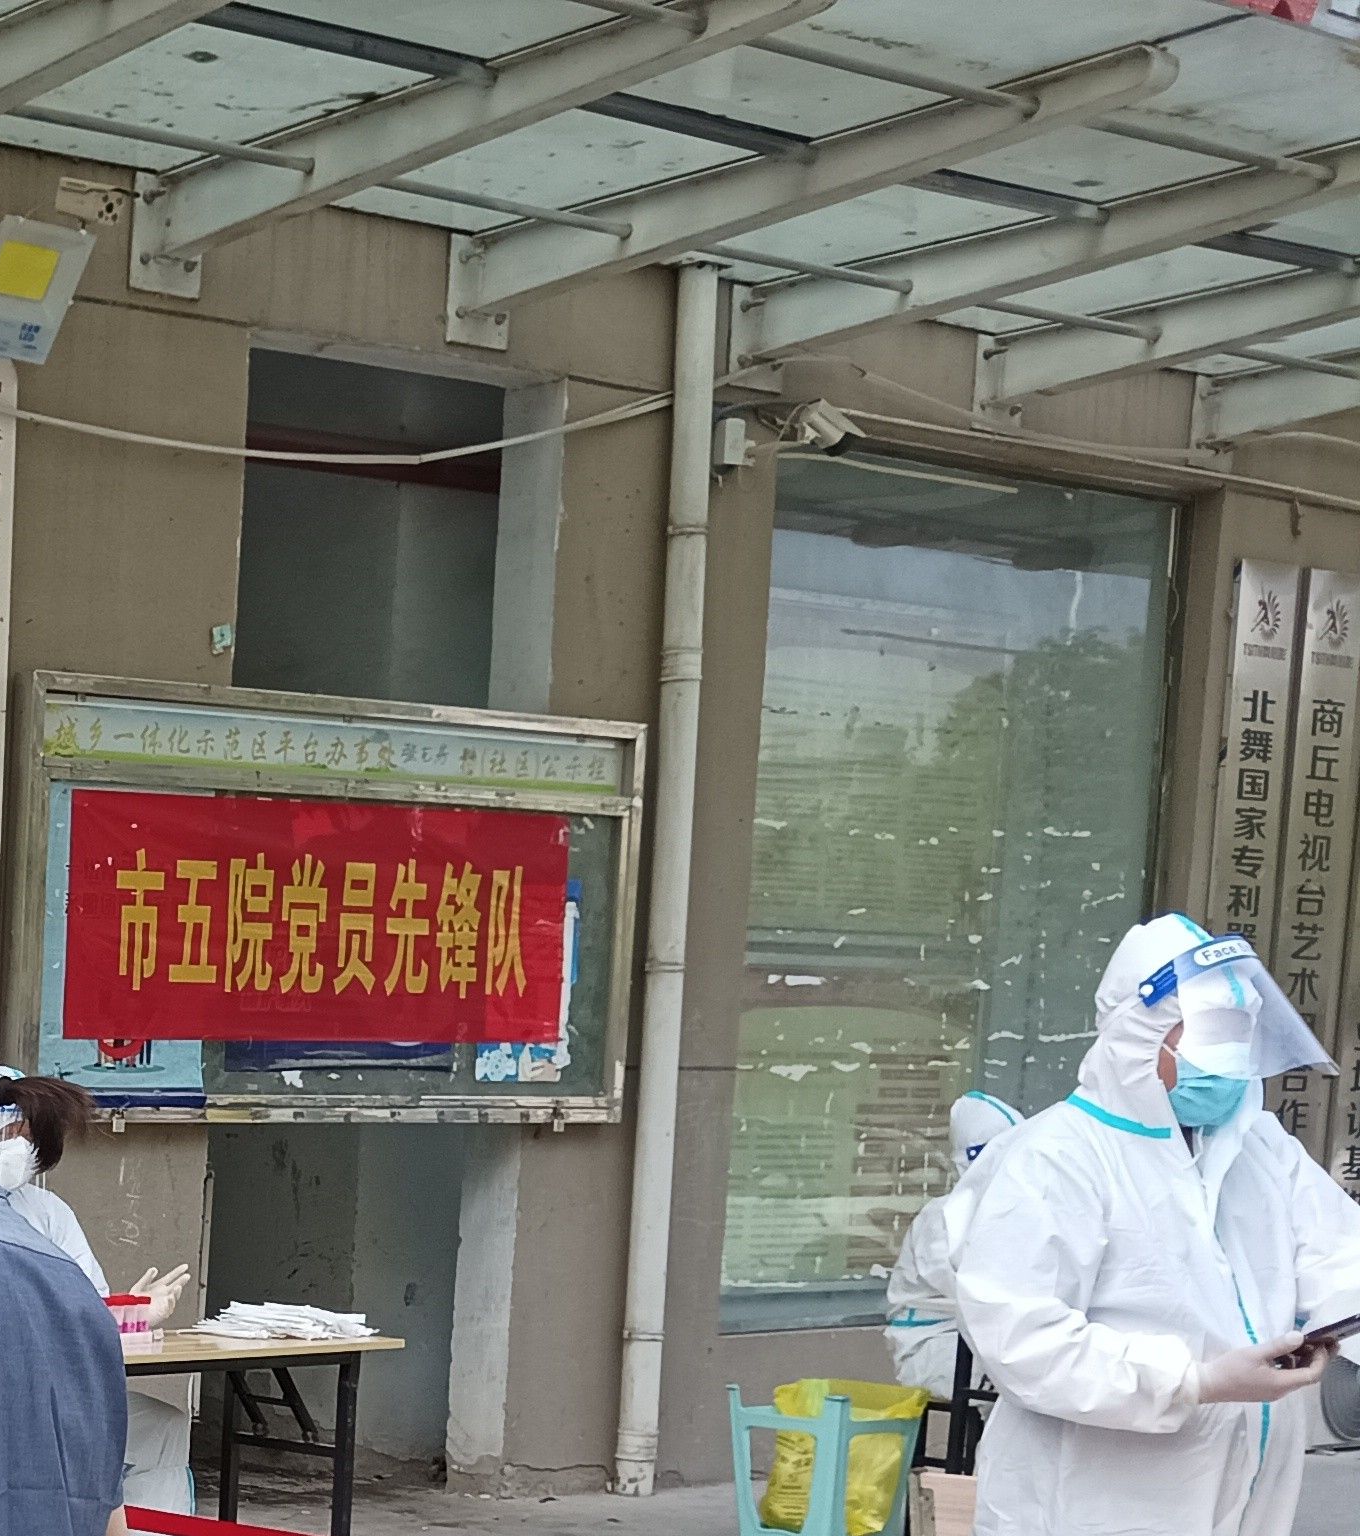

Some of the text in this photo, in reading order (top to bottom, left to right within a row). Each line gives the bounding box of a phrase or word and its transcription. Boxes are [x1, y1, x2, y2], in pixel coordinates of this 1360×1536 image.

[115, 848, 528, 1000] 市五院党员先锋队
[1277, 698, 1346, 1136] 商丘电视台艺术合作
